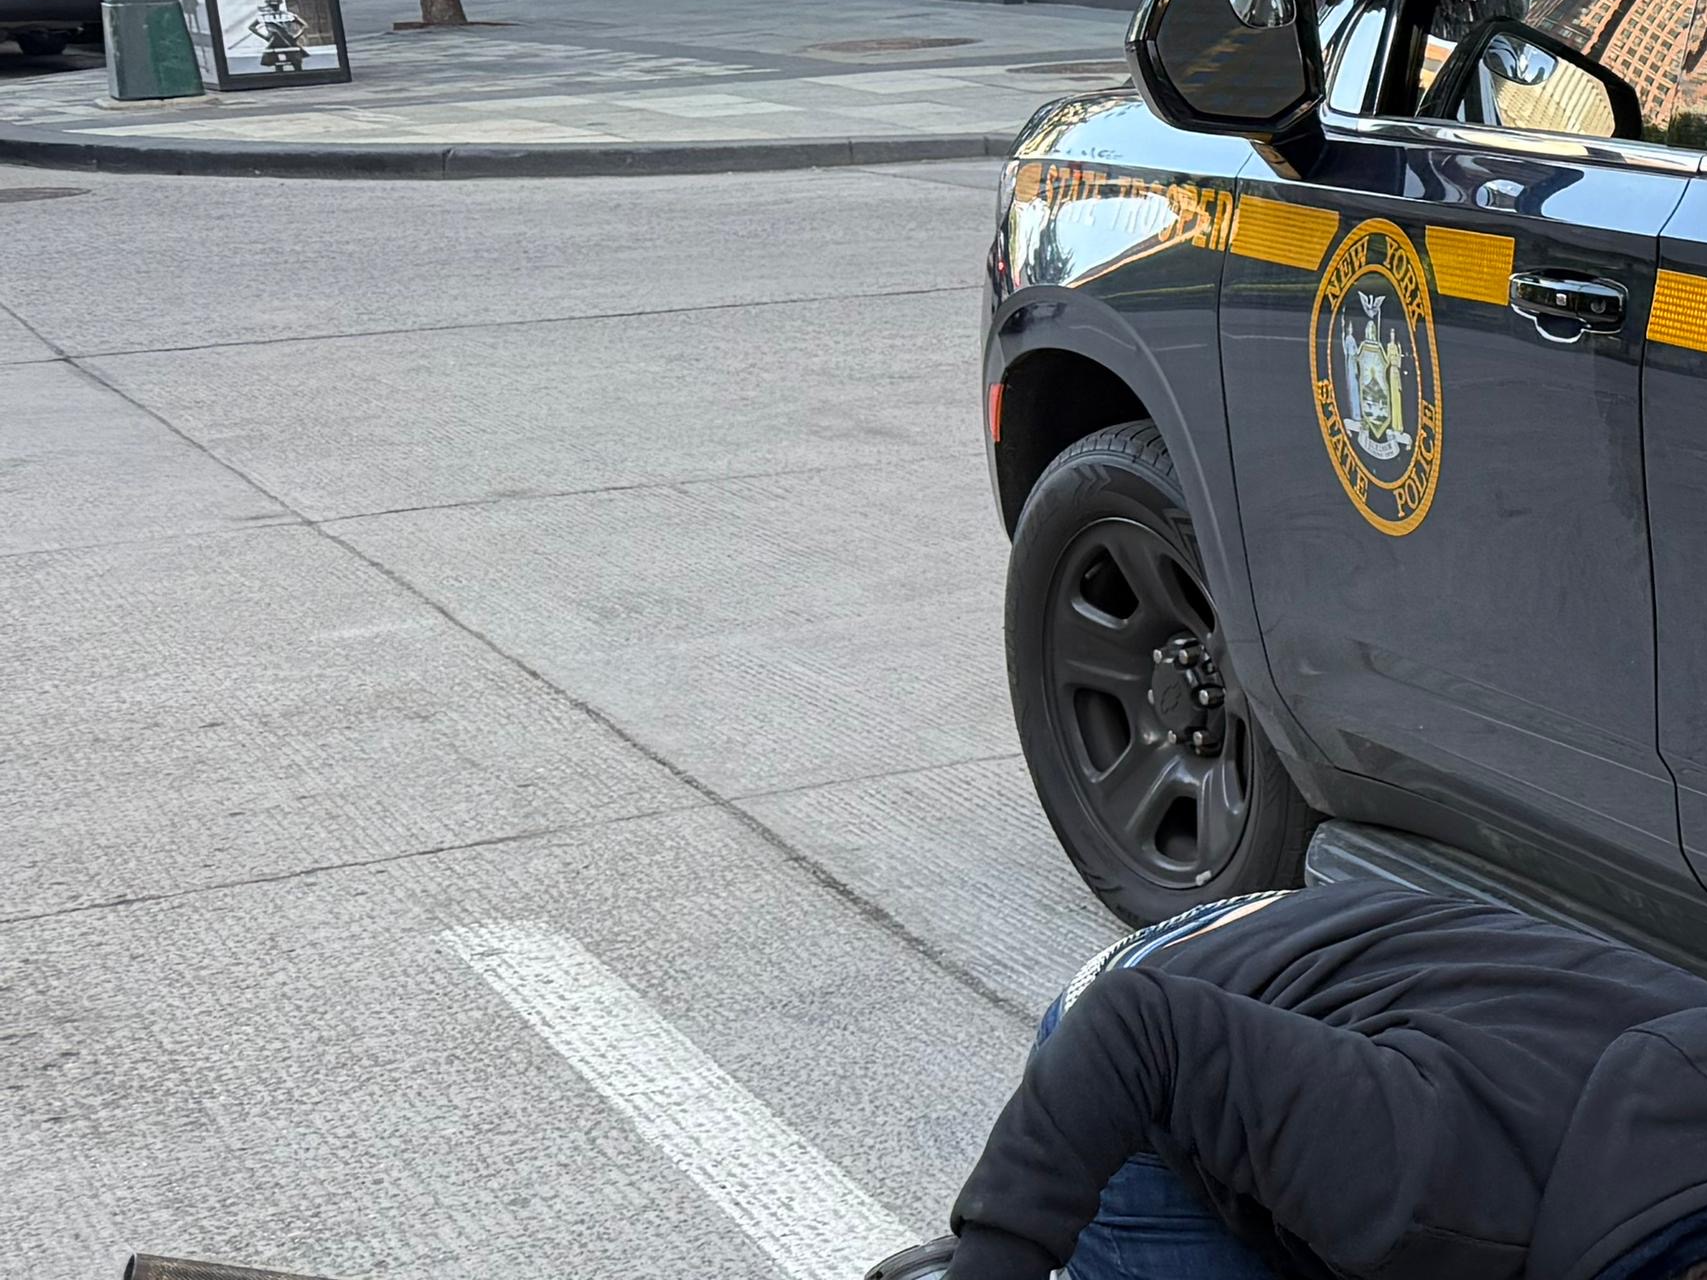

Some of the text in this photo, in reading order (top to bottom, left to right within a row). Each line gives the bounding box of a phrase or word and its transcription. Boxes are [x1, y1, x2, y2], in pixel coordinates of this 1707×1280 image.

[1327, 235, 1425, 332] NEW YORK
[1316, 379, 1436, 517] STATE POLICE
